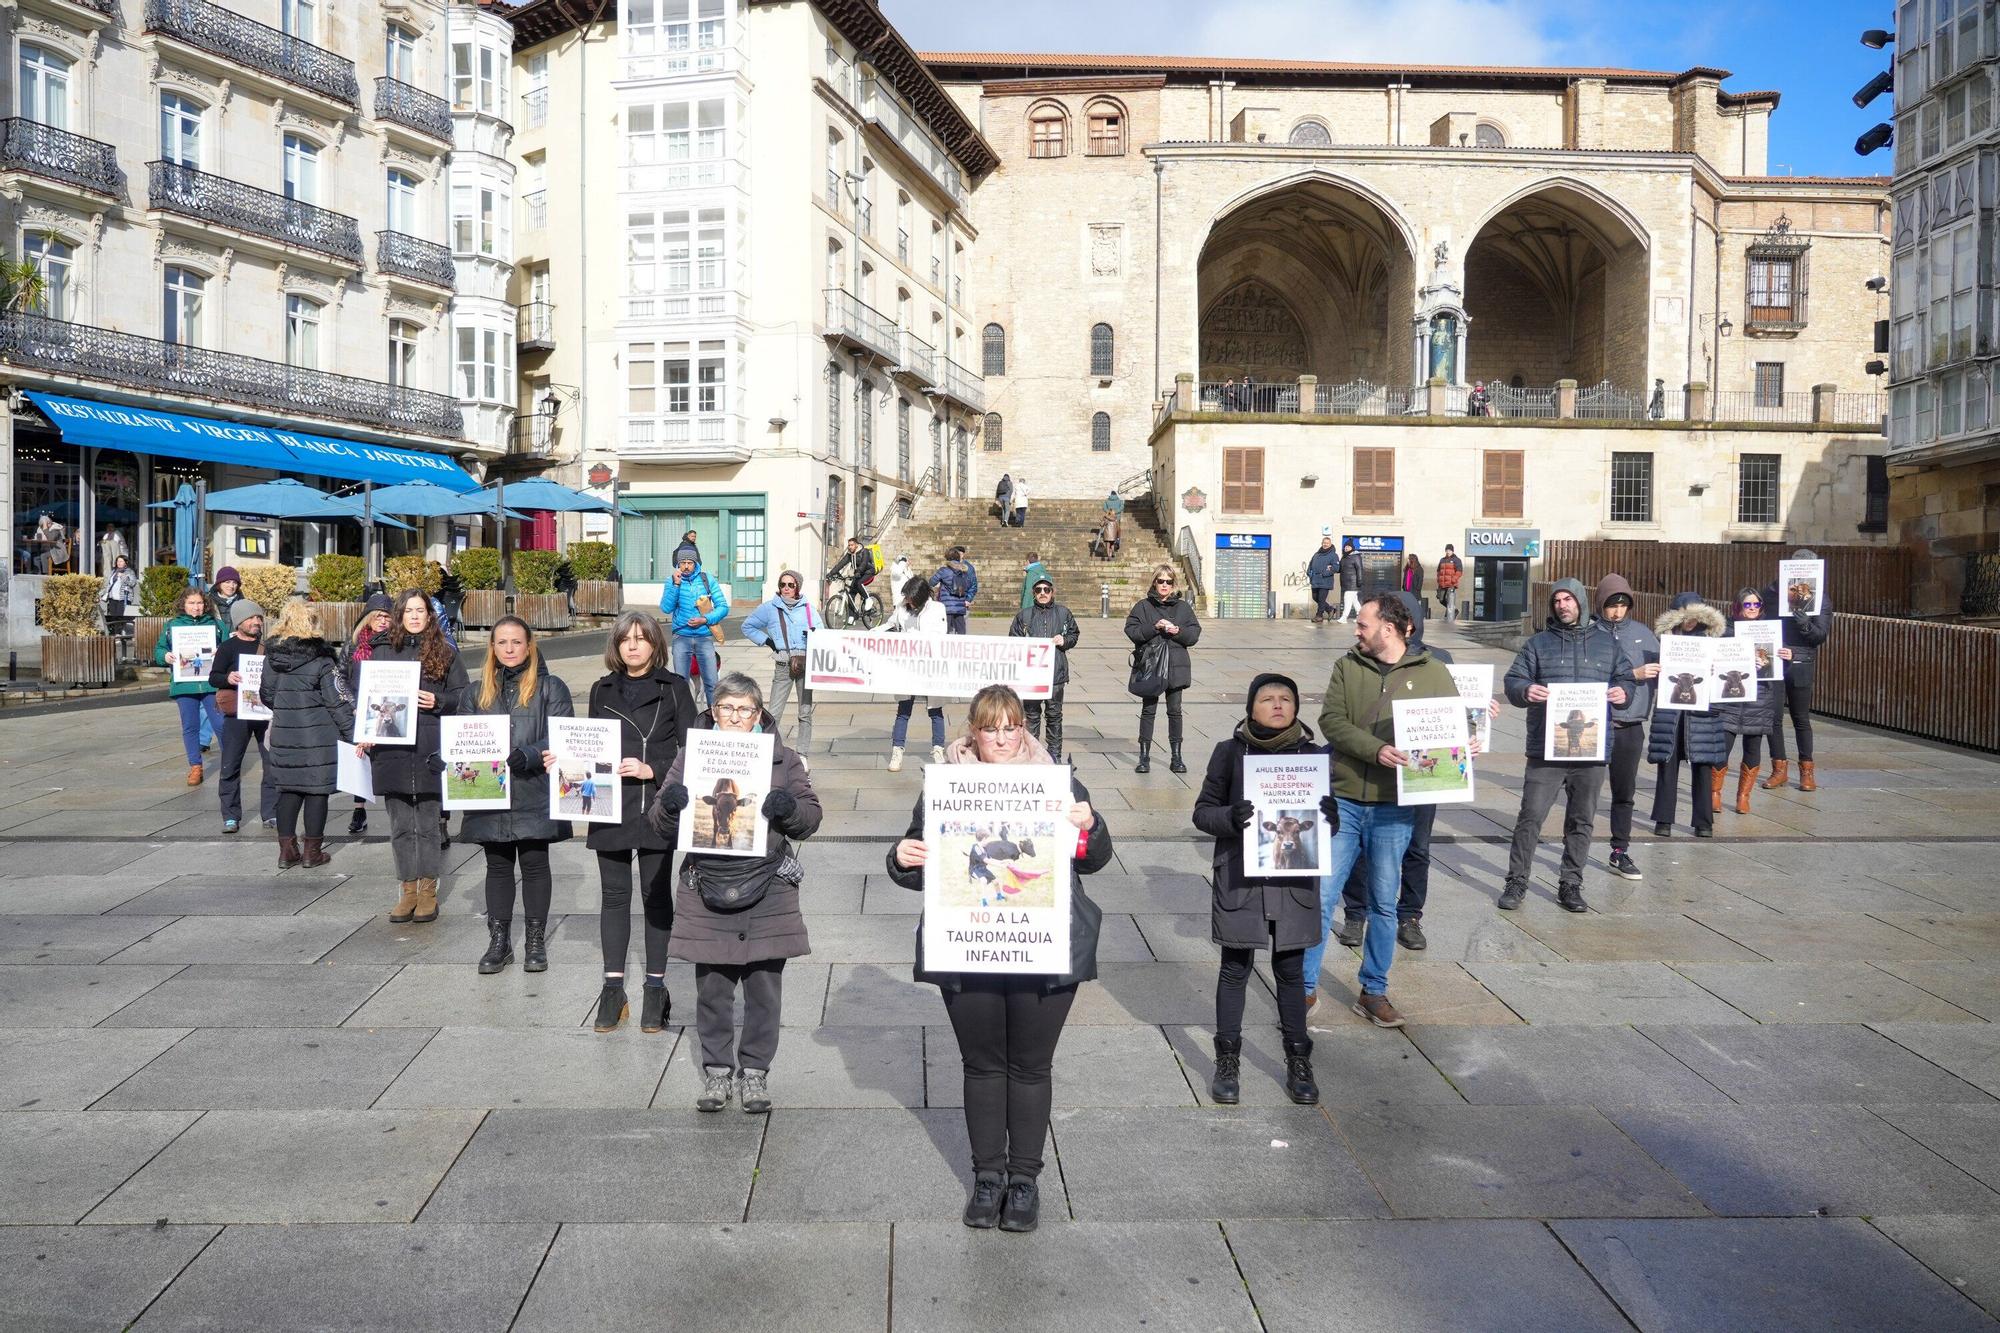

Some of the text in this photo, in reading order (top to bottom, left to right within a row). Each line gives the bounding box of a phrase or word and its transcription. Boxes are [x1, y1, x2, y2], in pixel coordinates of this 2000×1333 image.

[46, 400, 181, 433] RESTAURANTE
[182, 421, 274, 442] VIRGEN
[275, 434, 360, 458] BLANCA
[1470, 532, 1514, 545] ROMA
[940, 641, 1024, 662] UMEENTZAT
[1026, 644, 1050, 668] EZ
[812, 648, 836, 672] NO
[958, 661, 1020, 681] INFANTIL
[1406, 706, 1453, 715] PROTEJAMOS
[1406, 724, 1444, 733] ANIMALES
[700, 740, 735, 748] ANIMALIEI
[949, 782, 1045, 794] TAUROMAKIA
[932, 800, 1063, 812] HAURRENTZAT EZ
[970, 912, 1030, 924] NO A LA
[947, 931, 1052, 943] TAUROMAQUIA
[966, 950, 1034, 962] INFANTIL
